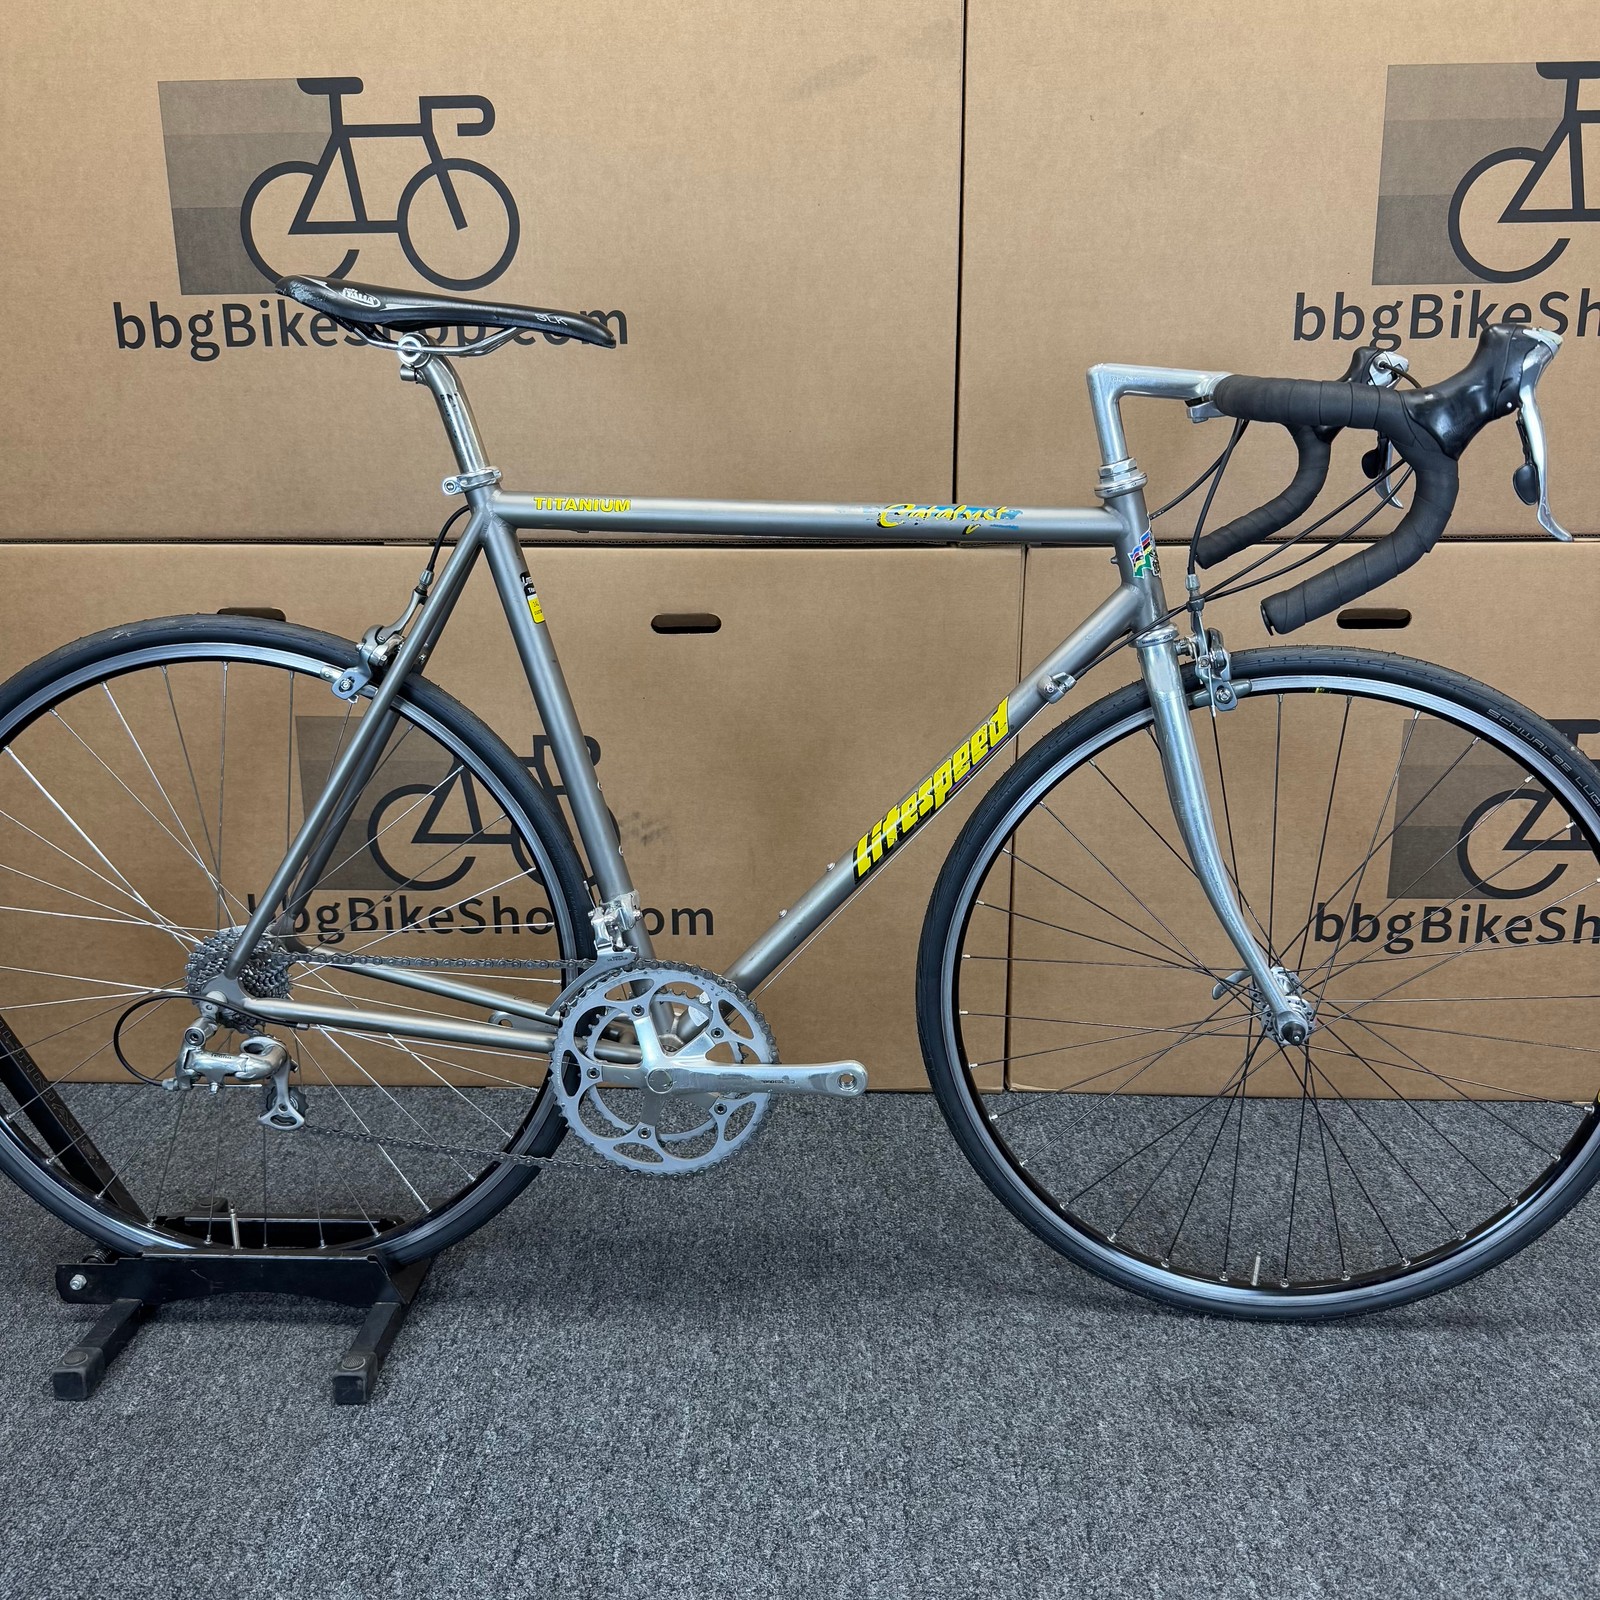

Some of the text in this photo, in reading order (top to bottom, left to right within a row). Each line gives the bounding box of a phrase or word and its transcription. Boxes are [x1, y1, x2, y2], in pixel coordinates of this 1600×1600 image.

[534, 303, 568, 326] SLK
[533, 496, 632, 512] TITANIUM
[877, 503, 1008, 535] Catalyst
[1486, 707, 1600, 807] SCHWALBE LUG
[853, 696, 1009, 879] Litespeed
[1313, 902, 1600, 956] bbgBikeSh
